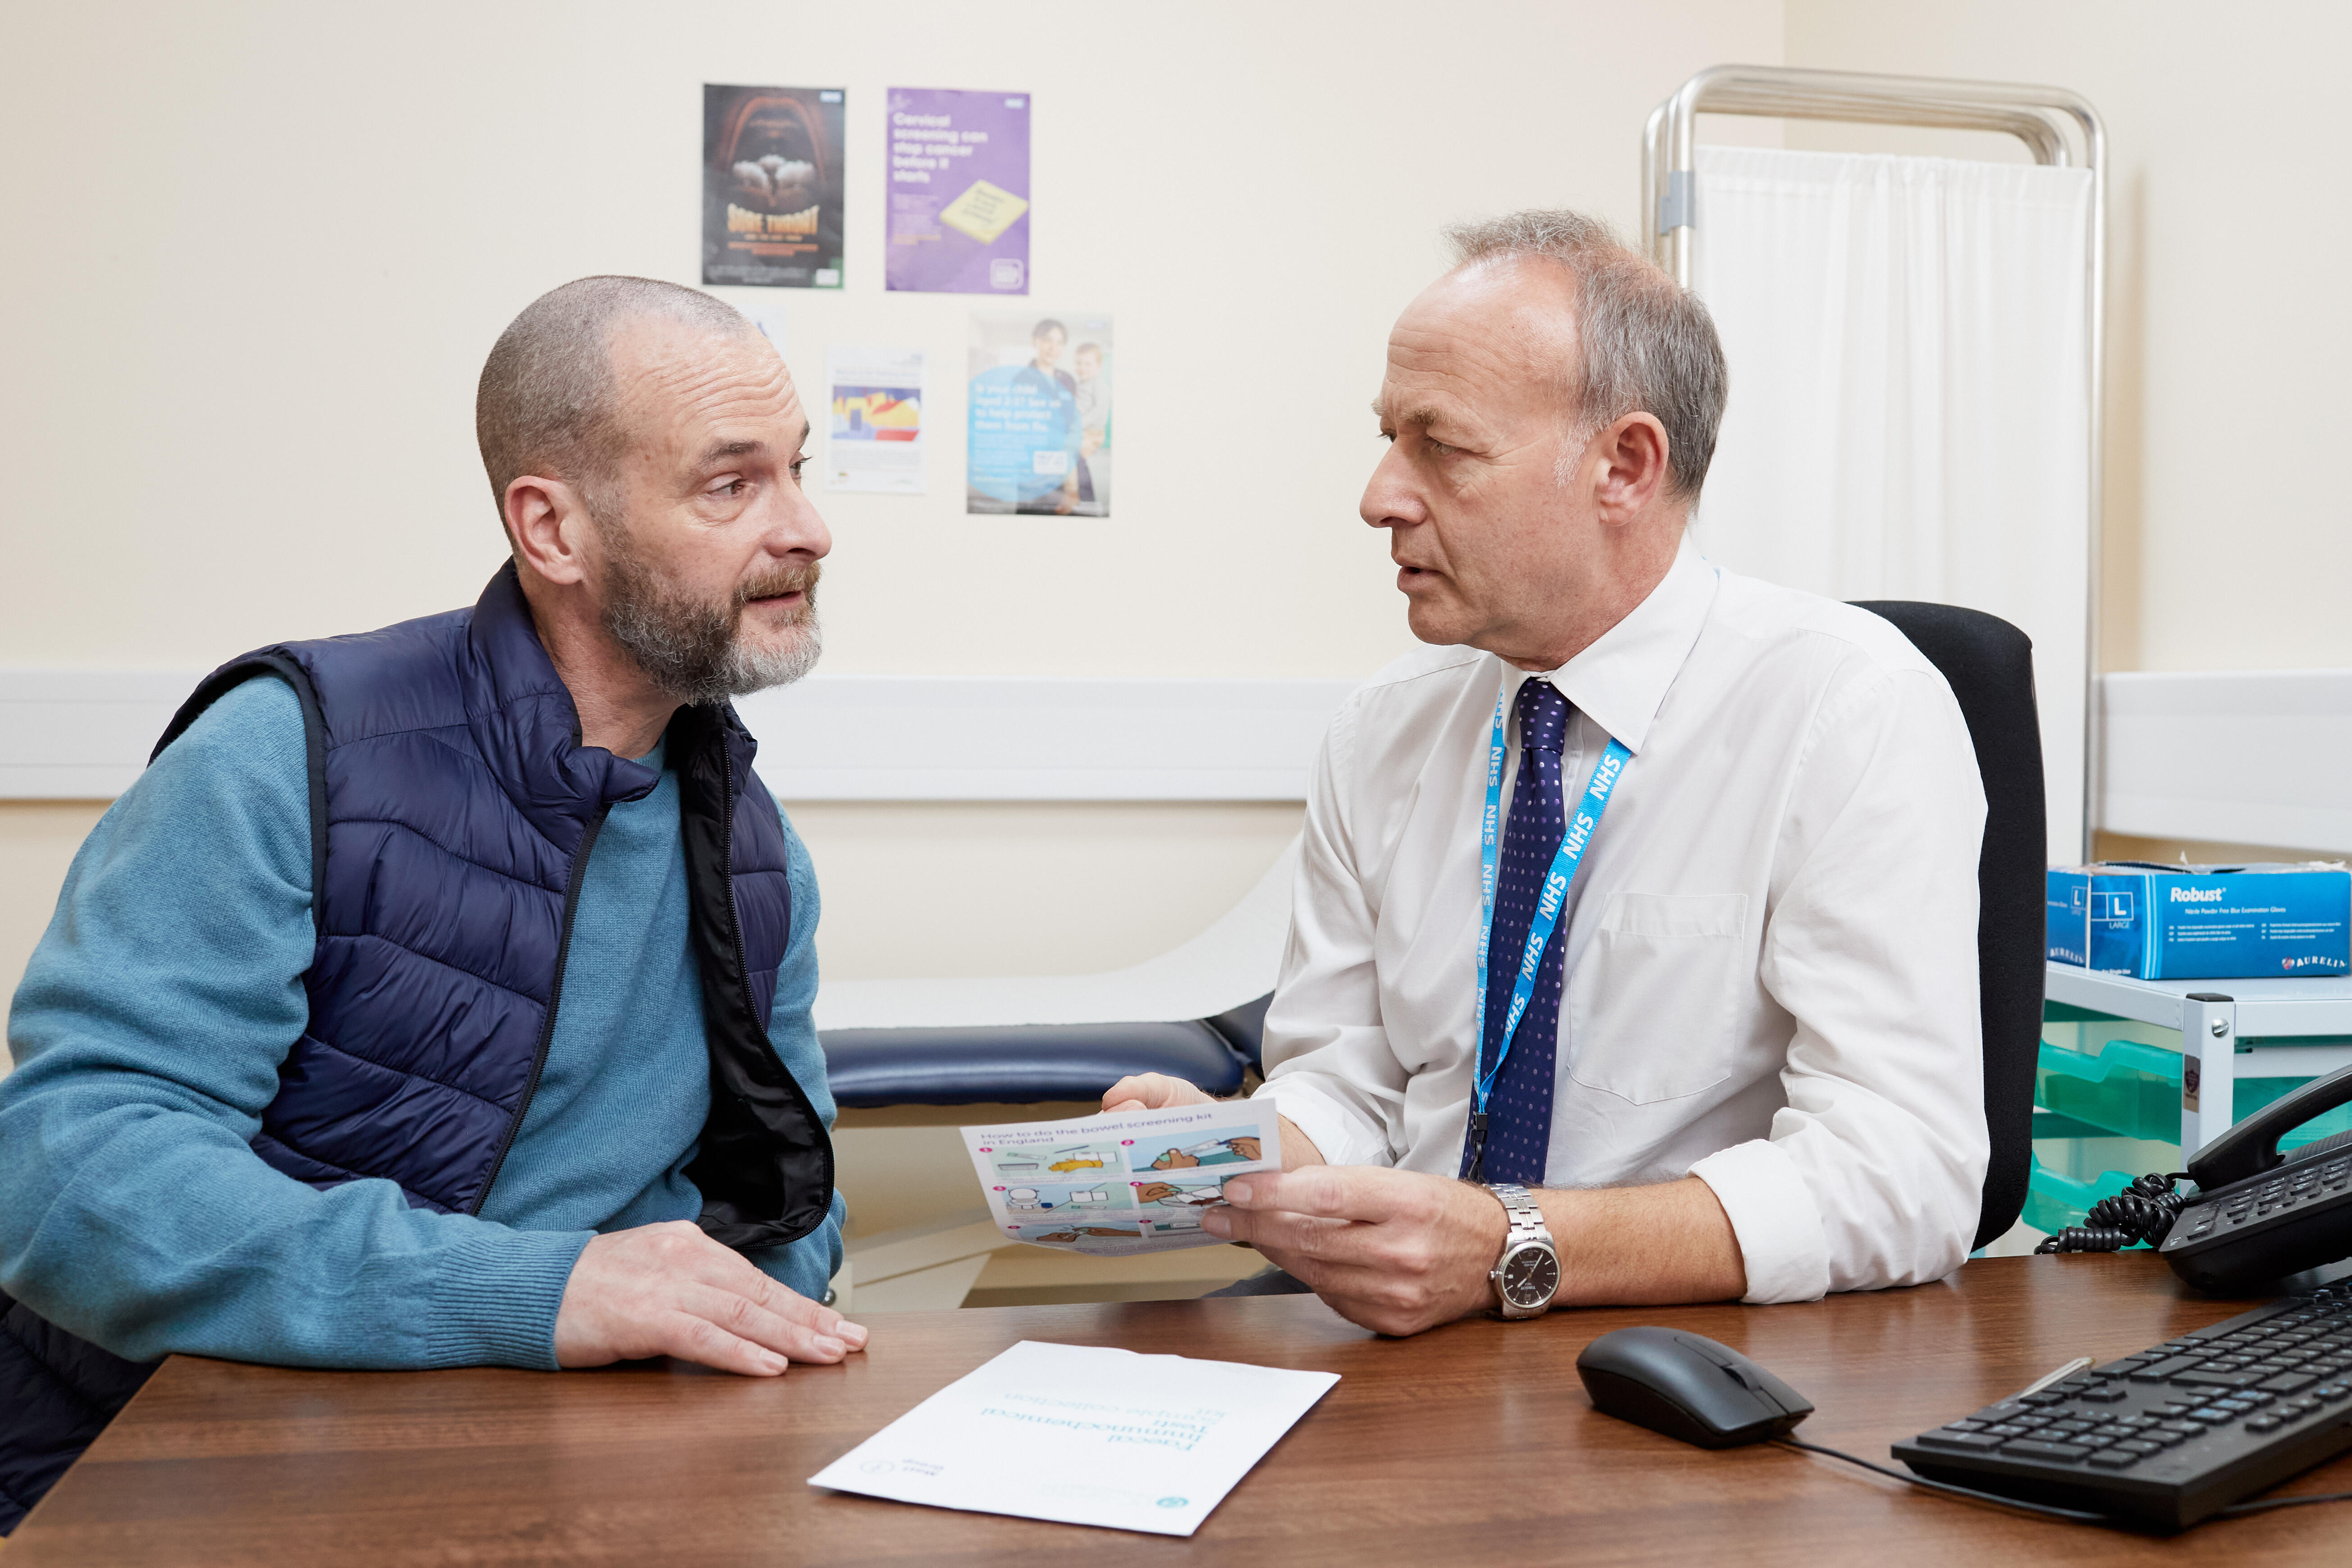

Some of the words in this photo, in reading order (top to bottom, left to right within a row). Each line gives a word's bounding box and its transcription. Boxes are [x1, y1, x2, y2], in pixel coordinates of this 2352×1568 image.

[894, 113, 950, 127] Cervical
[893, 129, 959, 143] screening
[960, 132, 988, 142] can
[893, 142, 923, 155] stop
[925, 144, 972, 156] cancer
[893, 156, 936, 169] before
[939, 157, 949, 169] it
[1013, 384, 1037, 395] child
[1014, 410, 1052, 421] protect
[1005, 420, 1029, 431] from
[1489, 747, 1502, 787] NHS
[1589, 754, 1621, 801] NHS
[1484, 805, 1497, 846] NHS
[1562, 812, 1594, 860] NHS
[1482, 864, 1493, 906] NHS
[1539, 871, 1566, 921] NHS
[2074, 889, 2081, 906] L
[2115, 897, 2127, 916] L
[1478, 925, 1490, 968] NHS
[1522, 932, 1543, 981] NHS
[2297, 956, 2345, 968] AURELIA
[1477, 987, 1485, 1032] NHS
[1505, 993, 1525, 1039] NHS
[1082, 1123, 1123, 1133] bowel
[1127, 1116, 1193, 1128] screening
[981, 1408, 1201, 1442] Immunochemical
[1107, 1435, 1192, 1451] Faecal
